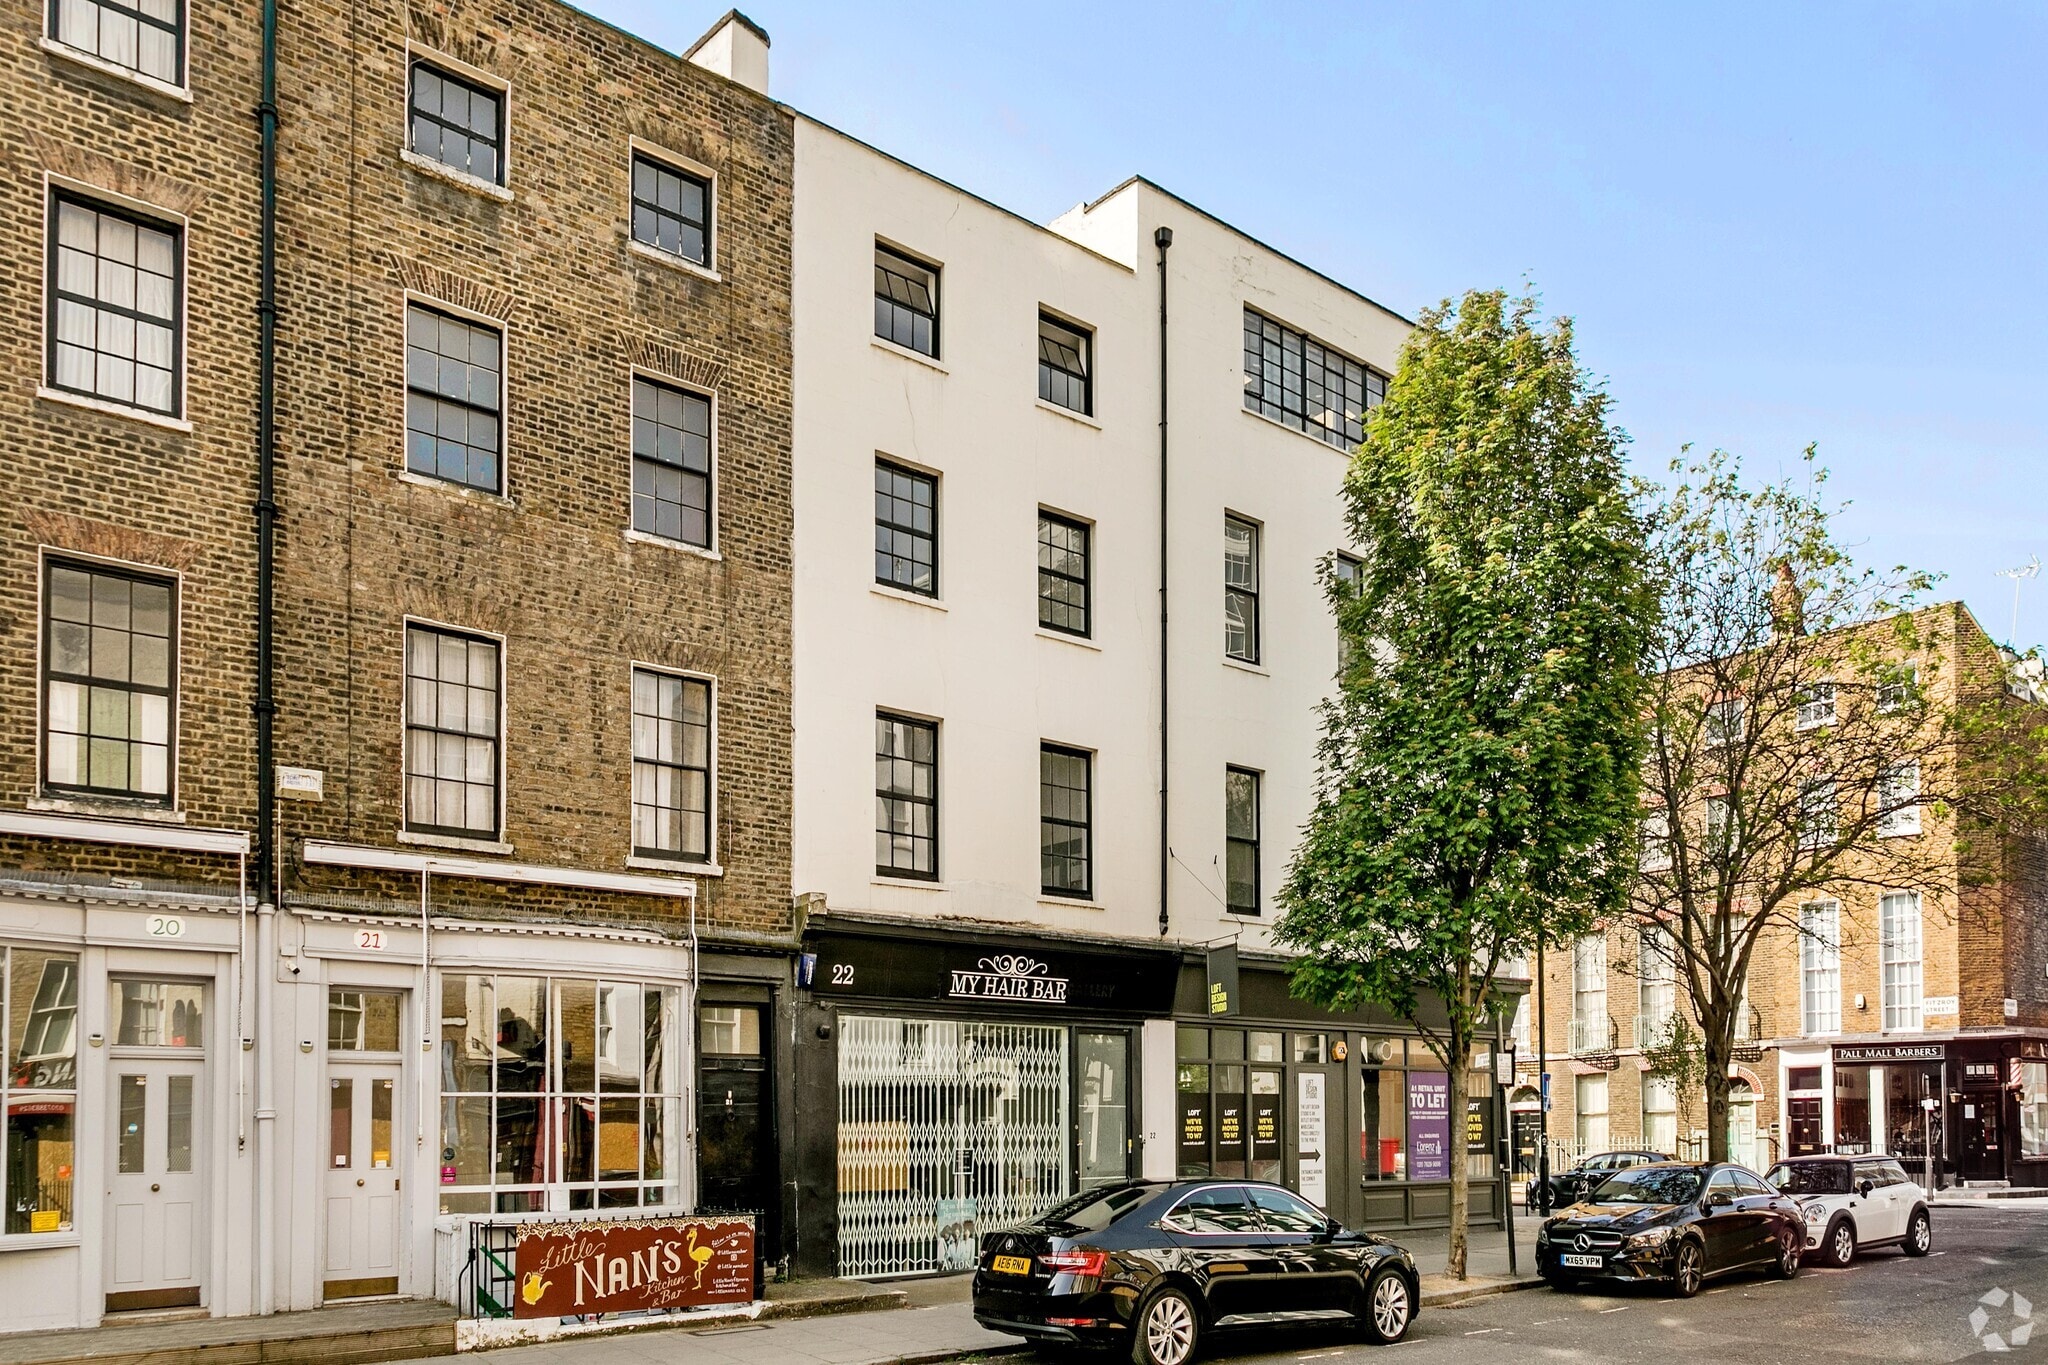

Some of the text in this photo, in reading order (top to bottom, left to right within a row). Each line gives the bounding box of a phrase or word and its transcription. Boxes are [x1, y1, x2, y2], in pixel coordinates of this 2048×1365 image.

[153, 918, 180, 936] 20
[361, 932, 381, 949] 21
[832, 964, 855, 985] 22
[950, 974, 1067, 1000] MY HAIR BAR
[1210, 982, 1222, 994] LOFT
[1840, 1048, 1938, 1058] PALL MALL BARBERS
[1410, 1093, 1447, 1108] TO LET
[539, 1237, 606, 1273] Little
[1565, 1256, 1584, 1265] MX65
[574, 1239, 682, 1306] NAN'S
[942, 1261, 971, 1270] AVLON
[998, 1258, 1024, 1271] AE16 RNA
[639, 1275, 691, 1300] Kitchen
[652, 1288, 686, 1307] & Bar
